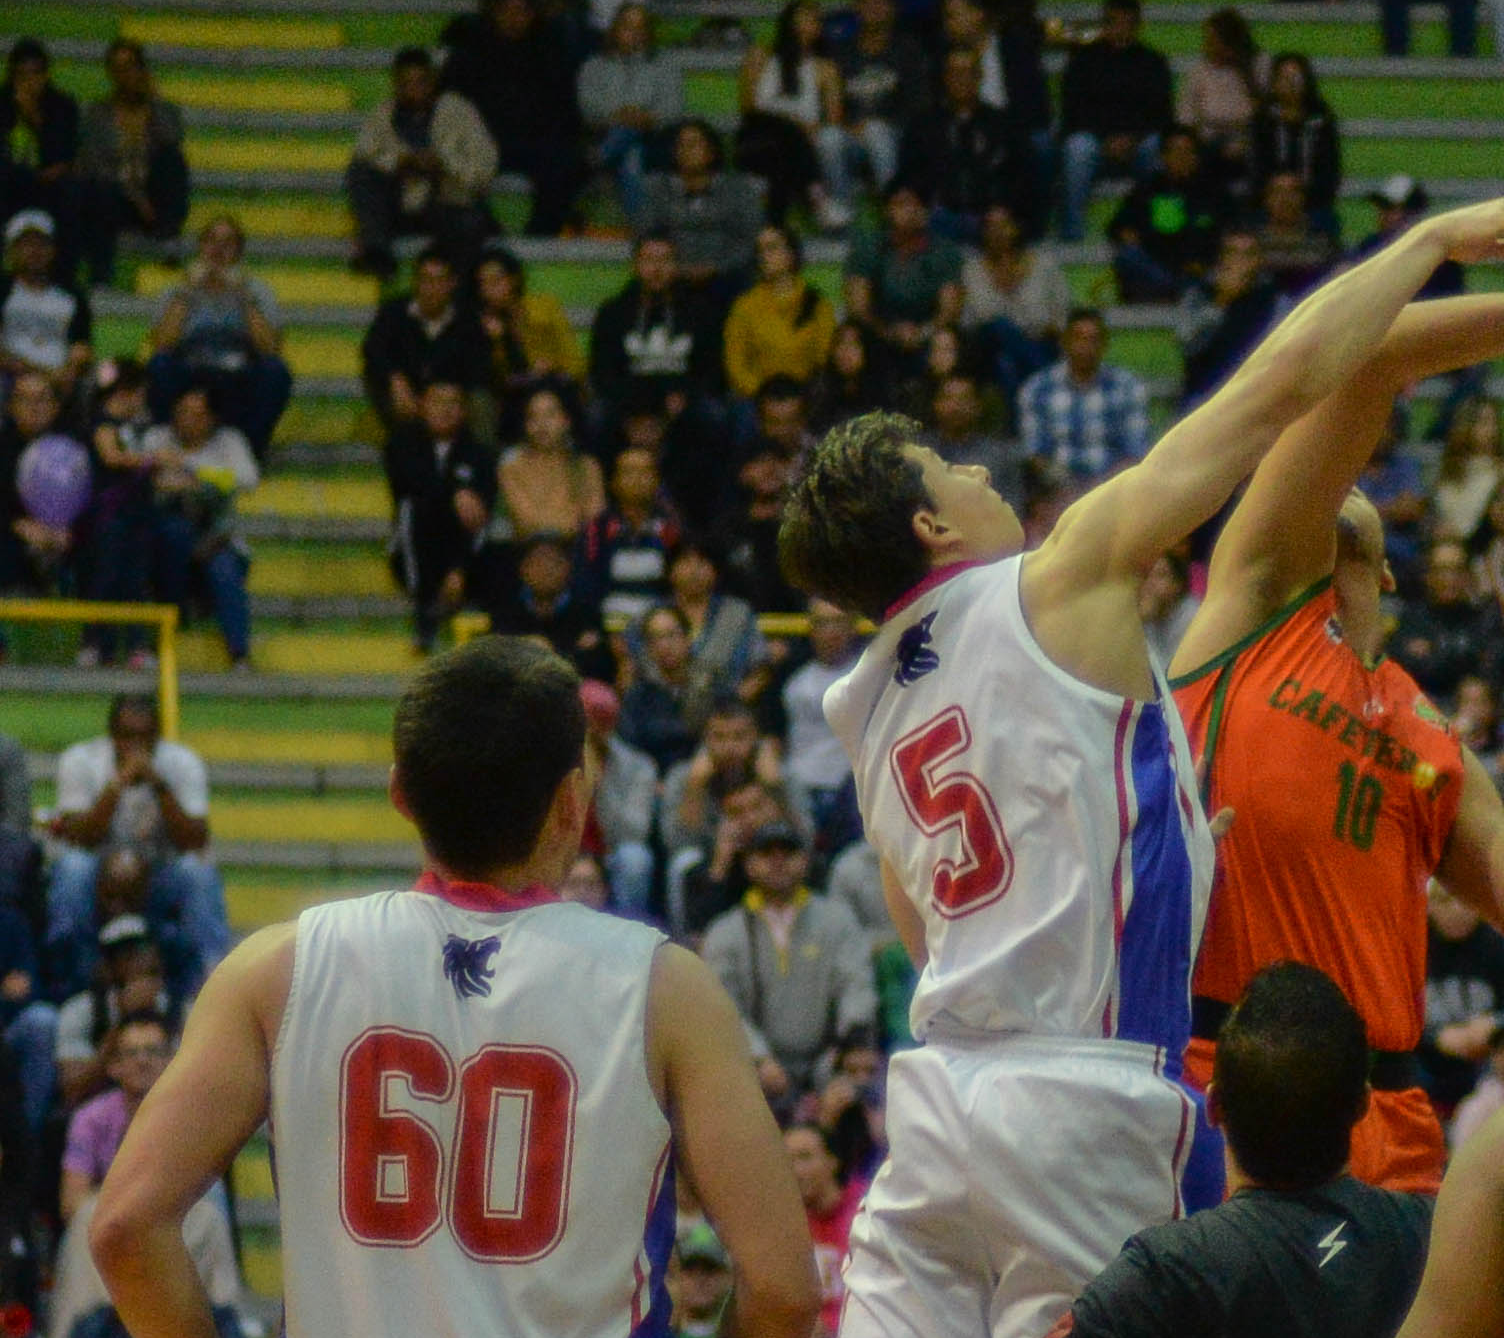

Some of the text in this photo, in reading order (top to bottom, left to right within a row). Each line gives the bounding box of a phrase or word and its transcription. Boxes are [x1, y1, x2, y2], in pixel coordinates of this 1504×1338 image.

[889, 704, 1015, 921] 5
[1333, 759, 1385, 851] 10
[338, 1024, 579, 1265] 60
